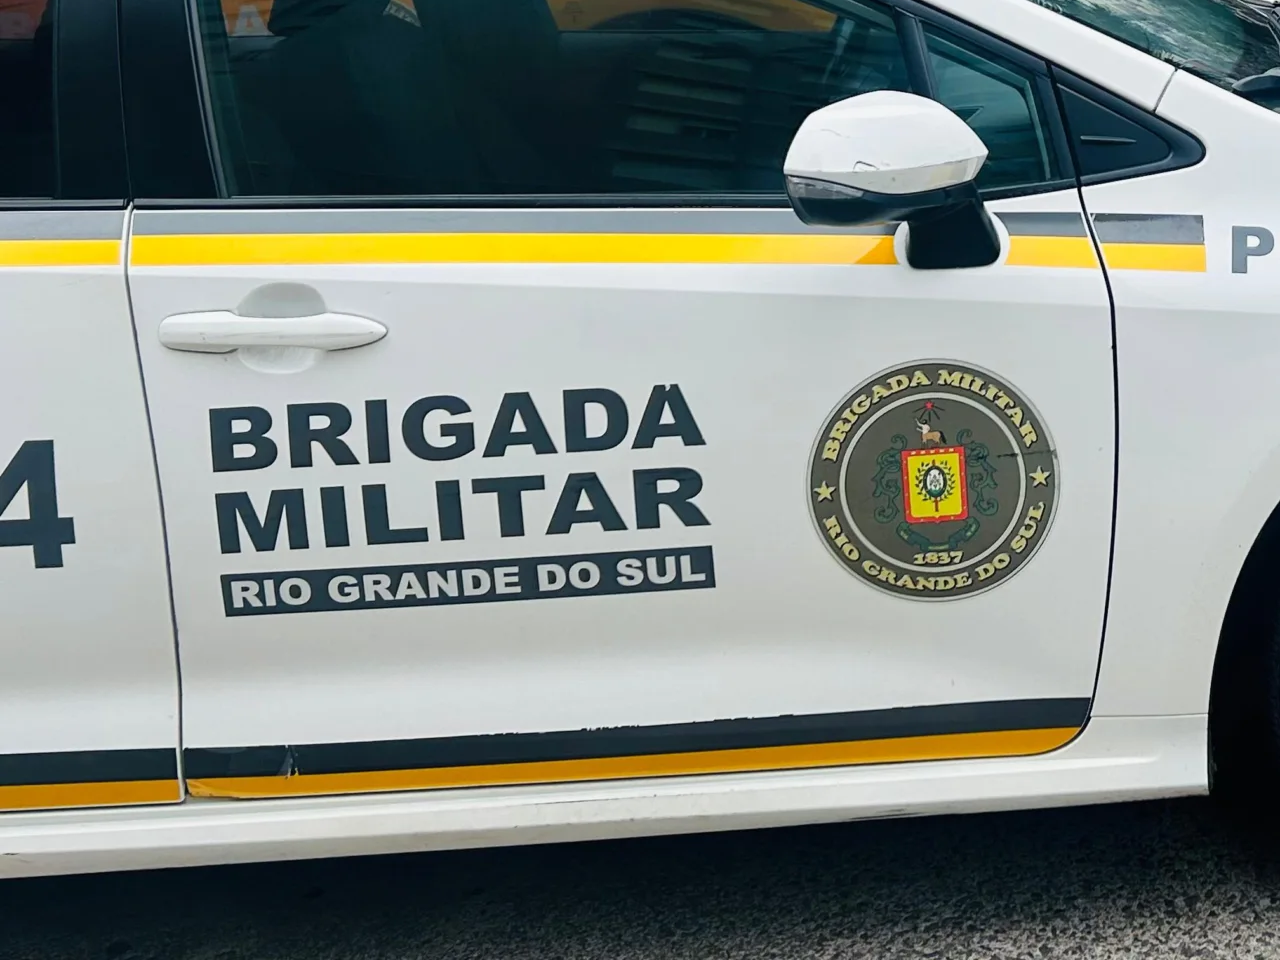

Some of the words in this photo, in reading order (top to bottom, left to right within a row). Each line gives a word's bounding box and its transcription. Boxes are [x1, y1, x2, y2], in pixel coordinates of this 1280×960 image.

[208, 383, 706, 473] BRIGADA
[822, 370, 931, 463] BRIGADA
[937, 369, 1038, 449] MILITAR
[215, 467, 711, 554] MILITAR
[823, 515, 860, 562] RIO
[862, 559, 972, 591] GRANDE
[977, 553, 1010, 581] DO
[1010, 501, 1045, 552] SUL
[230, 577, 311, 610] RIO
[327, 565, 522, 604] GRANDE
[537, 562, 599, 592] DO
[616, 553, 706, 588] SUL
[913, 551, 964, 566] 1837
